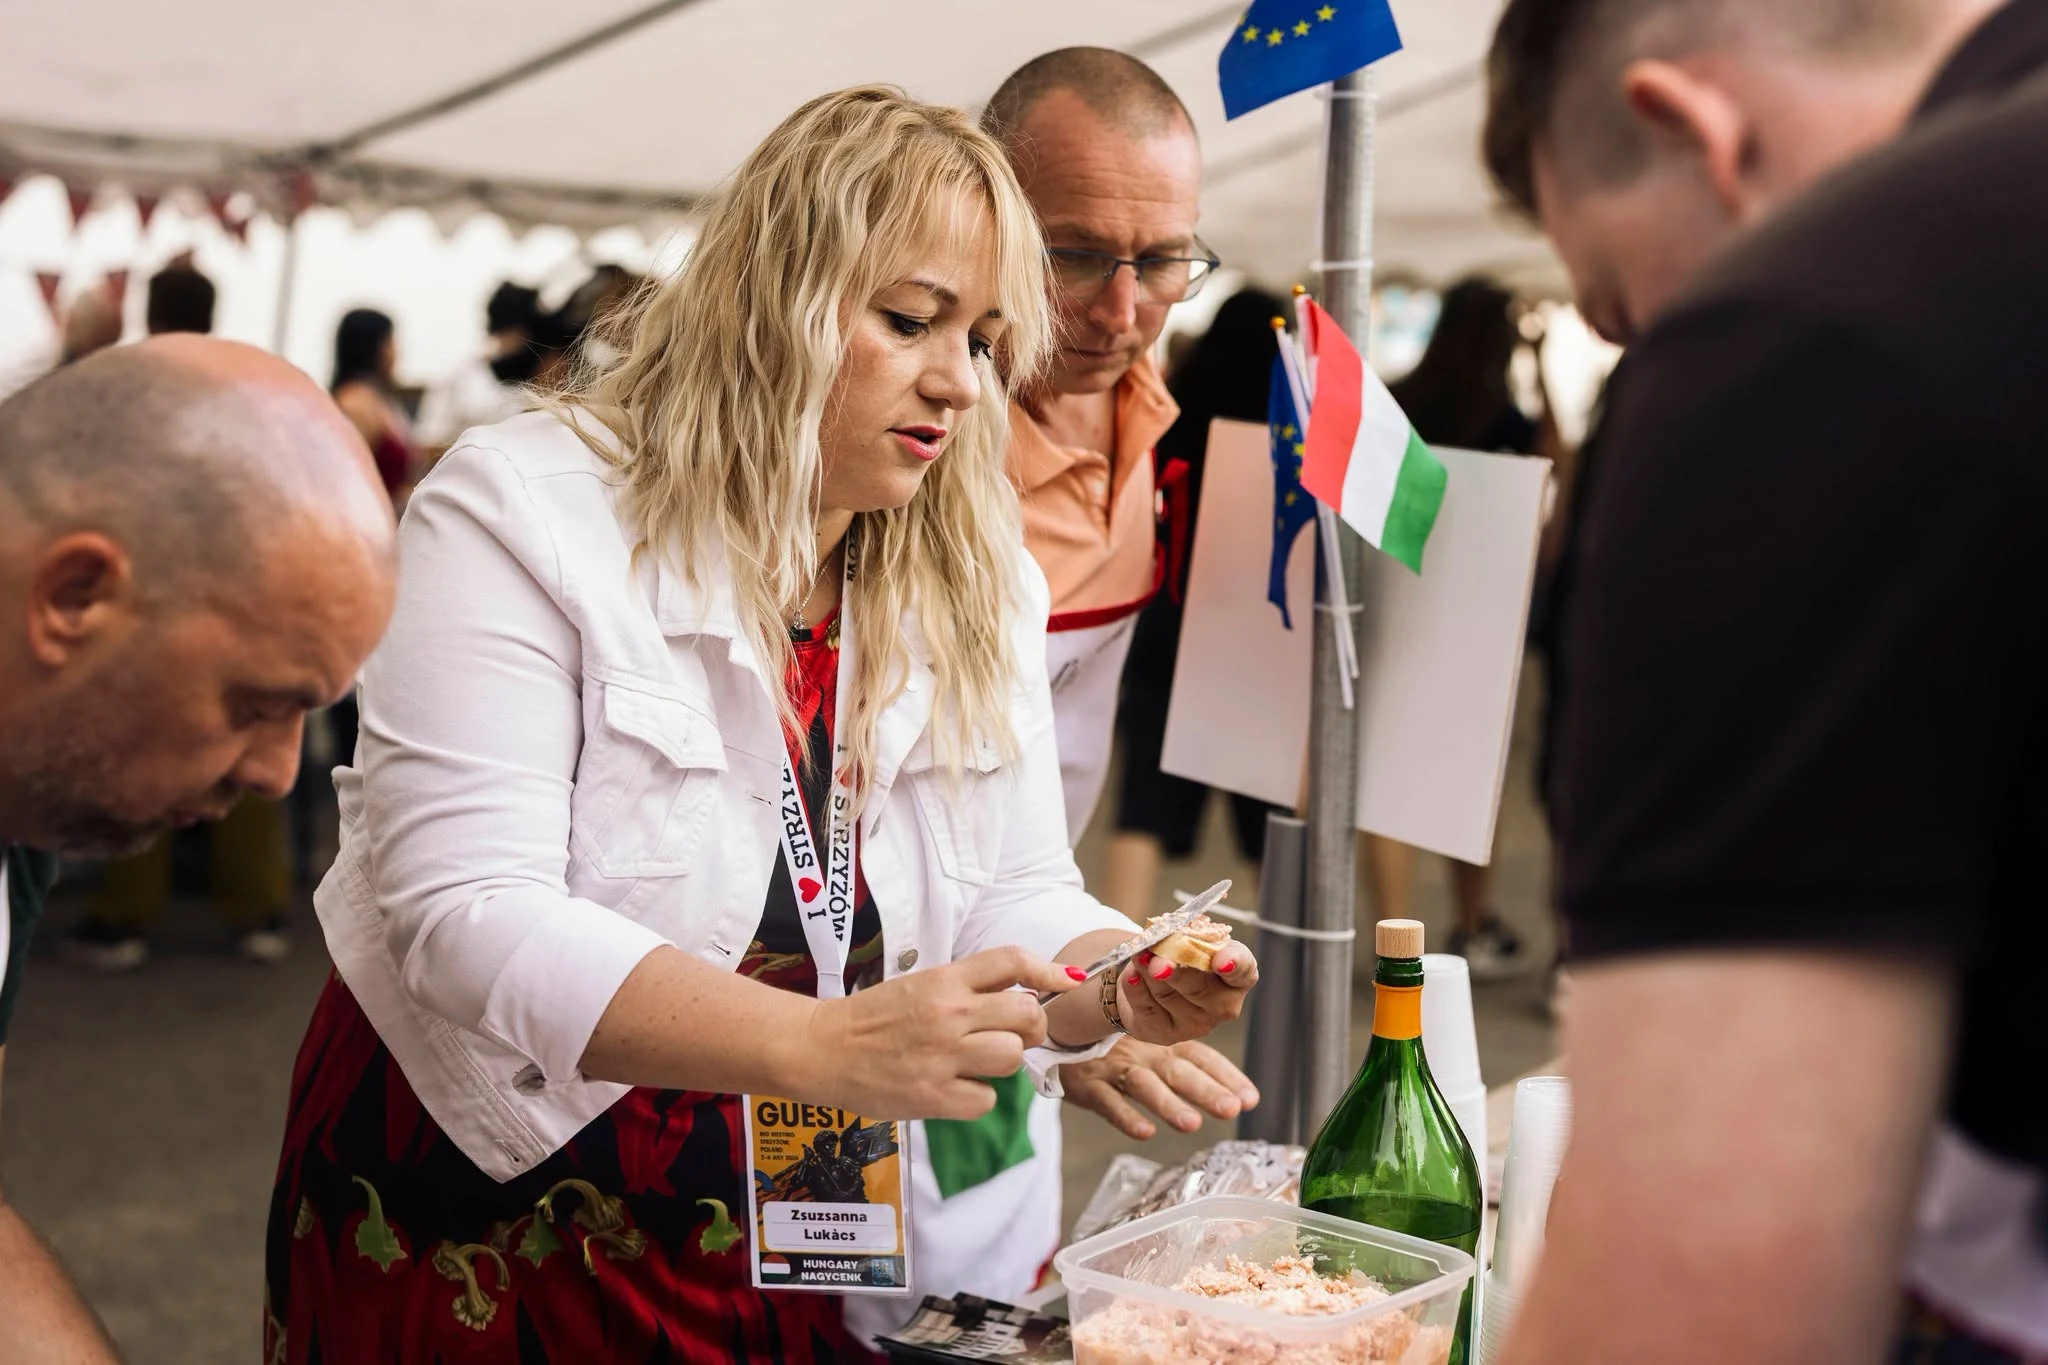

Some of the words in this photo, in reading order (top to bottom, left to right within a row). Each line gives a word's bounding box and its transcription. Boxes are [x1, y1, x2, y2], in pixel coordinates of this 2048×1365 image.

[807, 908, 826, 920] I
[791, 1210, 867, 1222] Zsuzsanna
[803, 1260, 858, 1270] HUNGARY
[801, 1272, 862, 1282] NAGYCENK
